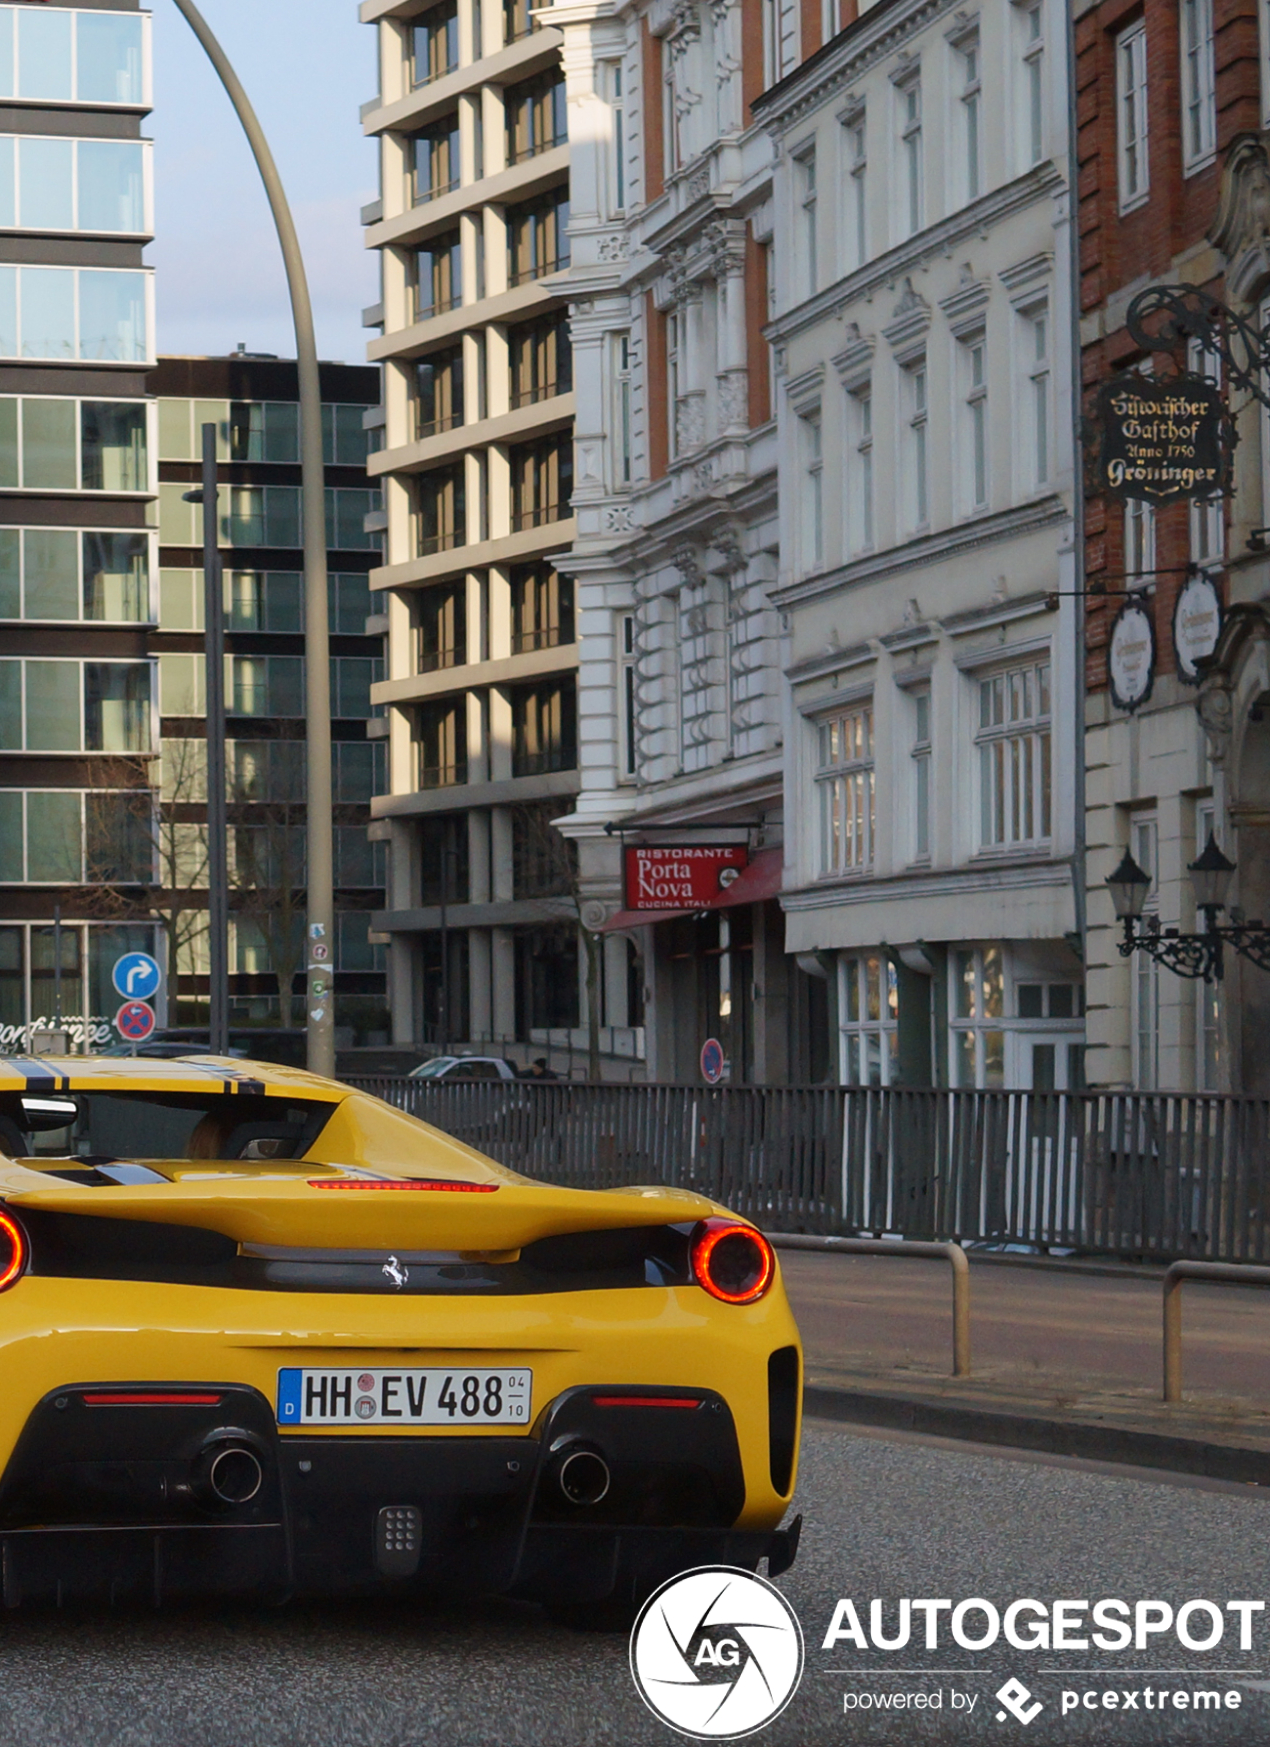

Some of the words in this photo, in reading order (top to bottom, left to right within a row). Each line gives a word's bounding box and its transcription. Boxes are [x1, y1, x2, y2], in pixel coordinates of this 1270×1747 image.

[1125, 443, 1163, 457] Anno
[1167, 444, 1195, 458] 1750
[637, 849, 733, 859] RISTORANTE
[638, 859, 691, 879] Porta
[638, 878, 693, 898] Nova
[637, 900, 680, 909] CUCINA
[508, 1376, 524, 1388] 04
[305, 1376, 352, 1417] HH
[381, 1376, 427, 1417] EV
[437, 1375, 503, 1417] 488
[284, 1402, 295, 1415] D
[508, 1405, 524, 1417] 10
